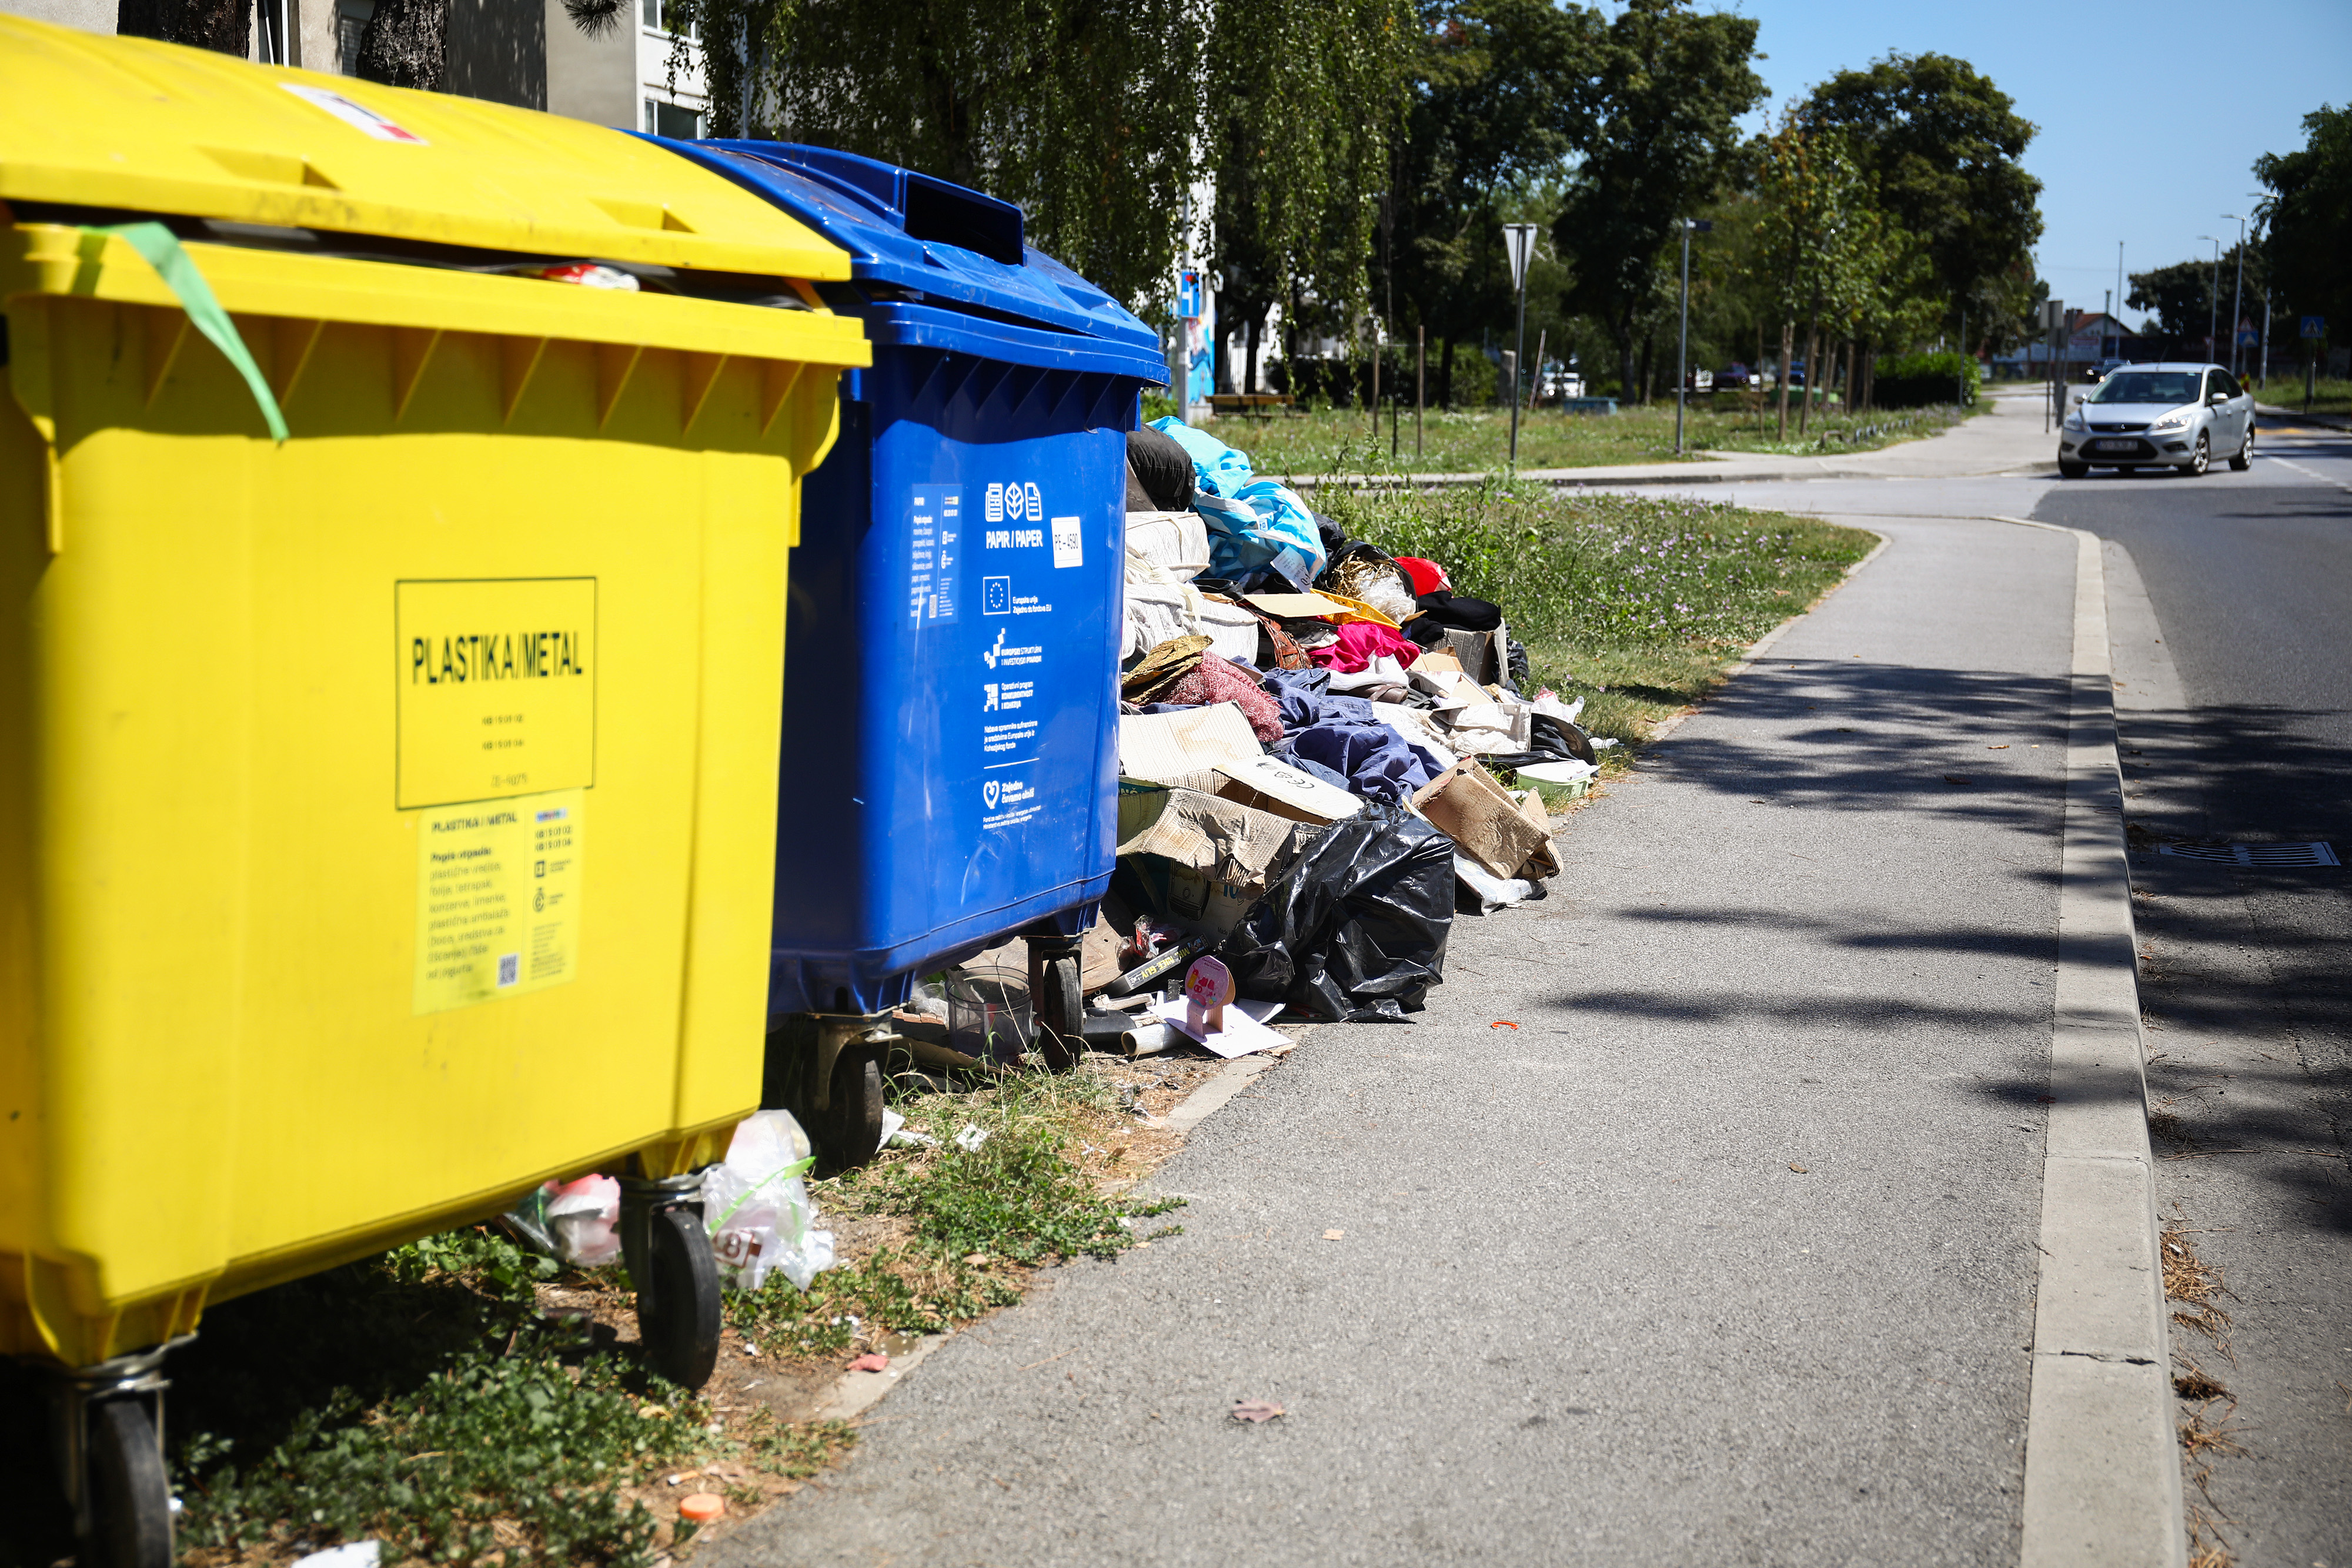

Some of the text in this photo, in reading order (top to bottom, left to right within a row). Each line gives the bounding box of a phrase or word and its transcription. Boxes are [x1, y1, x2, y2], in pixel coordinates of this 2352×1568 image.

[986, 530, 1010, 549] PAPIR
[1015, 530, 1043, 547] PAPER
[1019, 681, 1034, 690] program
[1001, 781, 1023, 793] Zajedno
[1001, 793, 1021, 804] čuvamo
[431, 817, 478, 834] PLASTIKA
[487, 812, 517, 827] METAL
[1141, 947, 1190, 980] MR. NICE GUY
